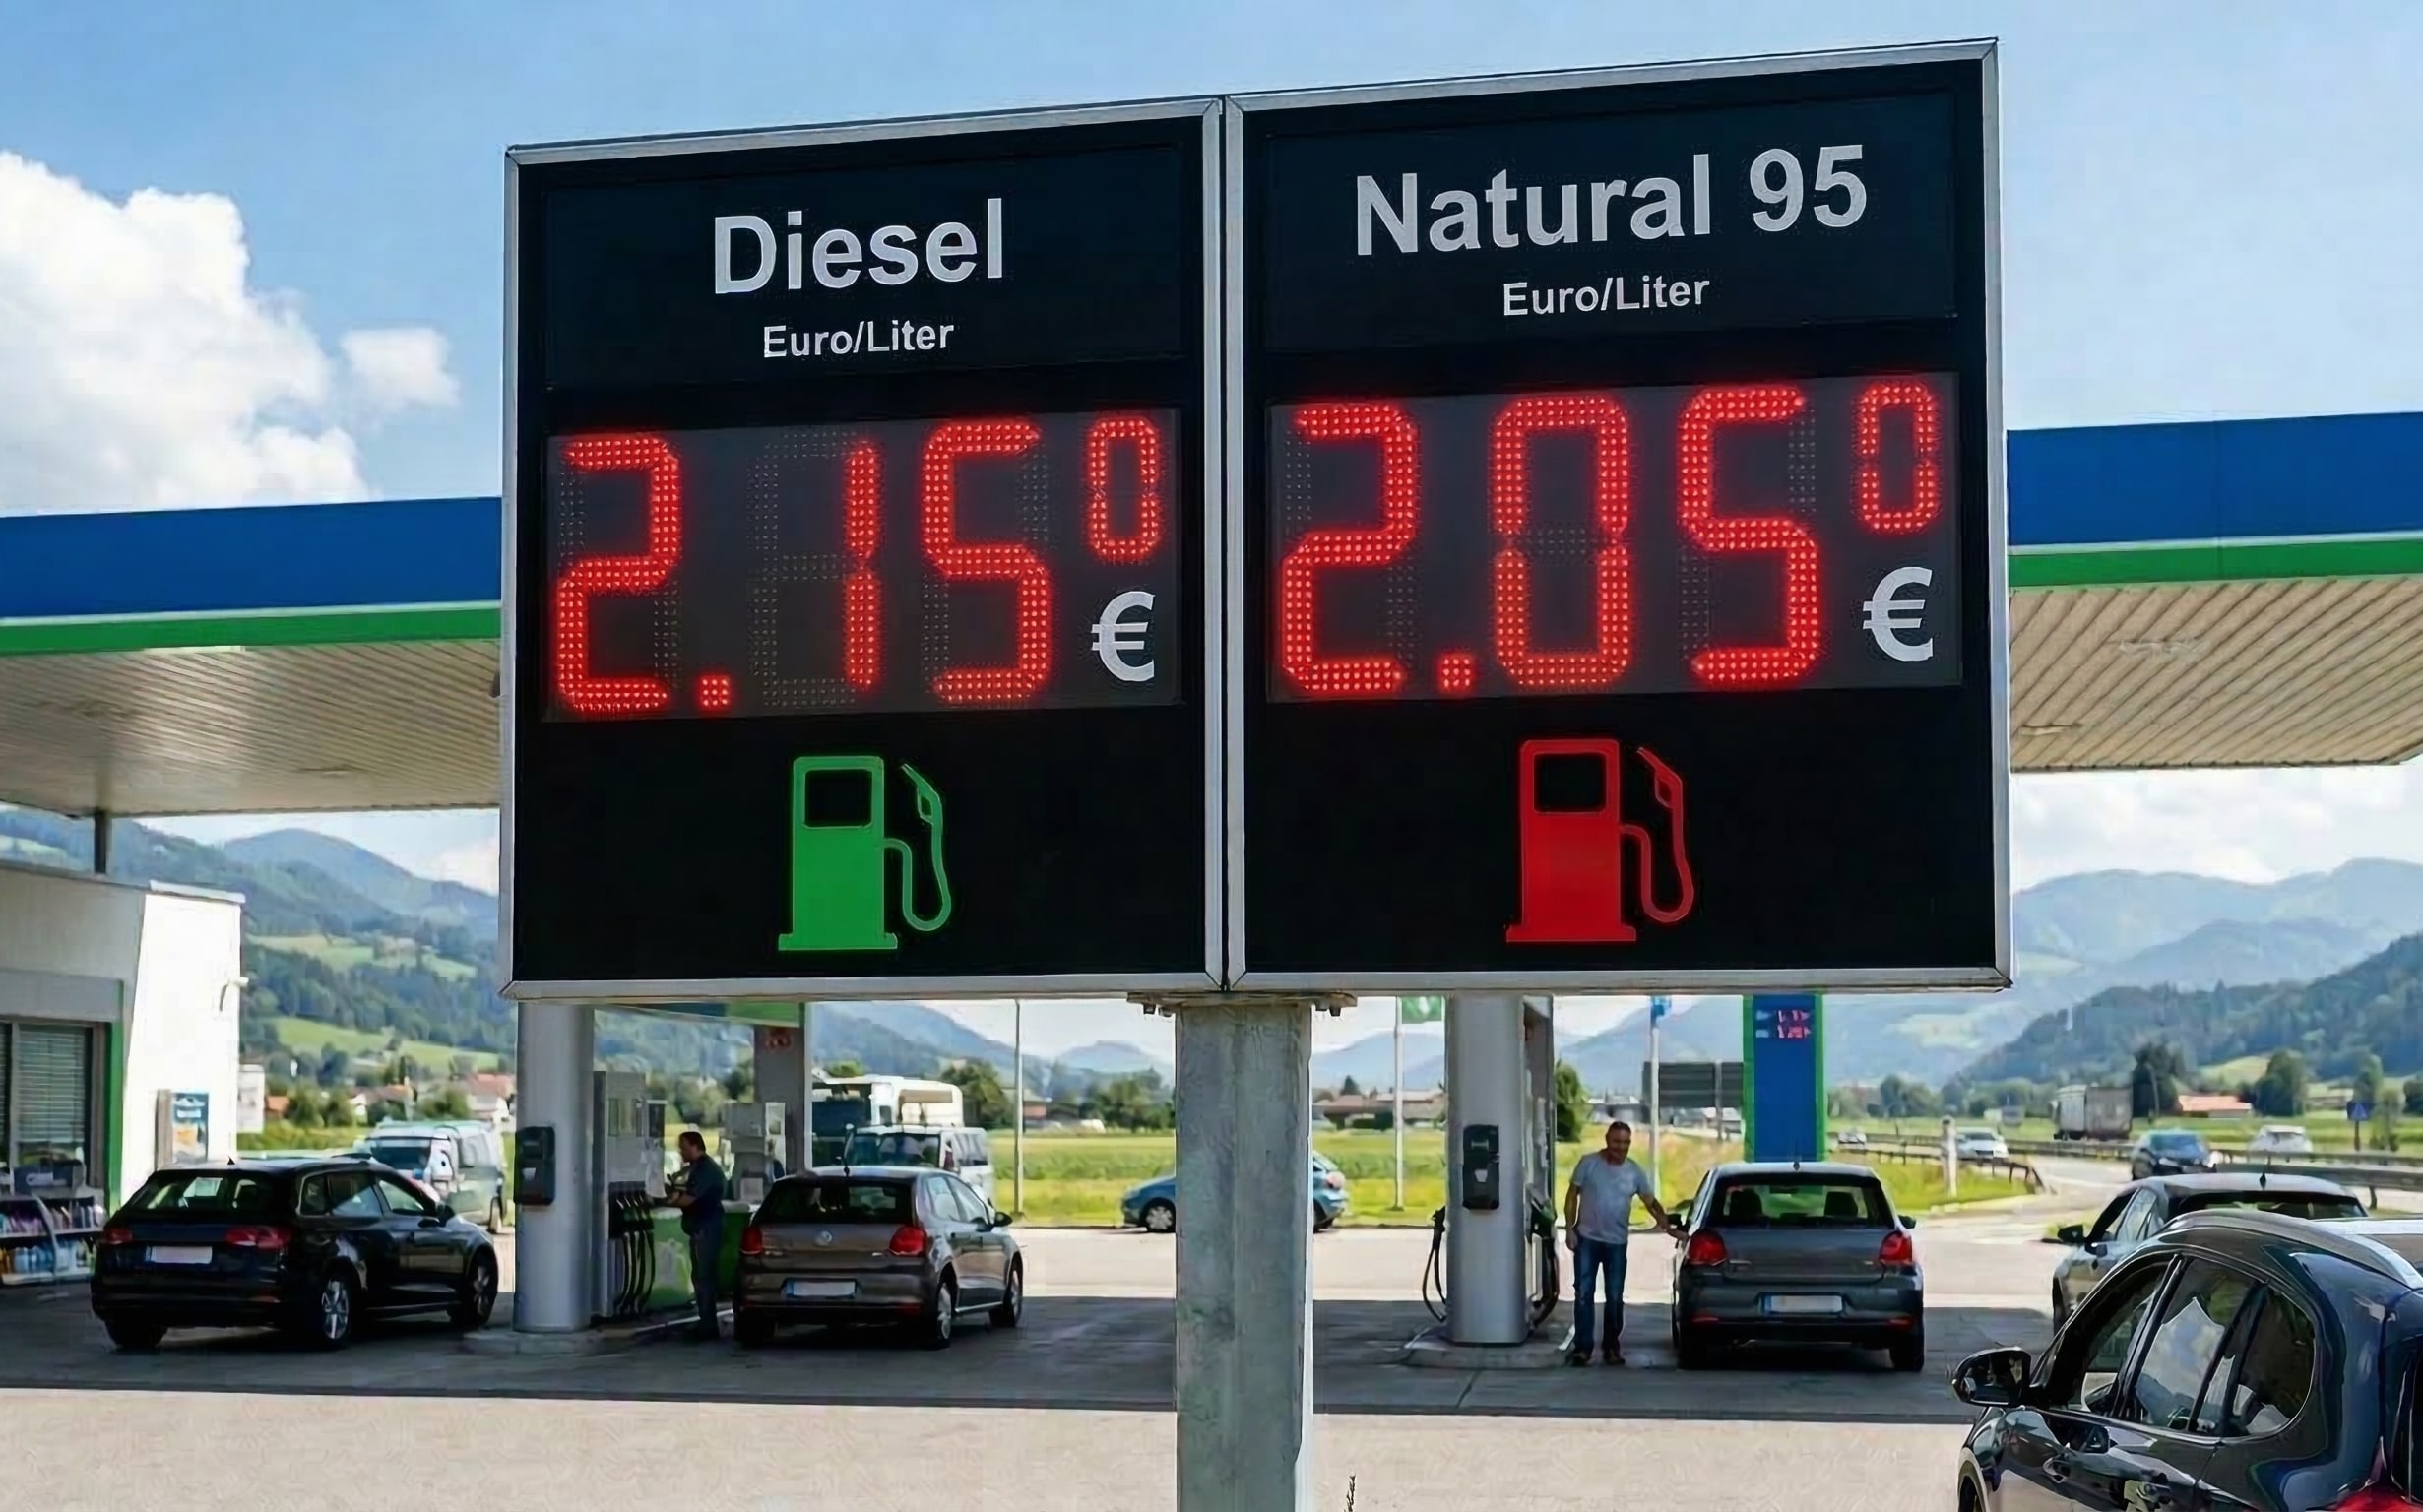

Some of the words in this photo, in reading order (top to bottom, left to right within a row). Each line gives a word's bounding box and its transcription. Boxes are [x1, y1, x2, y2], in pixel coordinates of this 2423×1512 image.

[715, 198, 1002, 293] Diesel
[1358, 154, 1710, 255] Natural
[1751, 145, 1866, 232] 95
[764, 320, 955, 358] Euro/Liter
[1504, 276, 1710, 316] Euro/Liter
[1091, 591, 1156, 682] €
[1863, 567, 1934, 662] €
